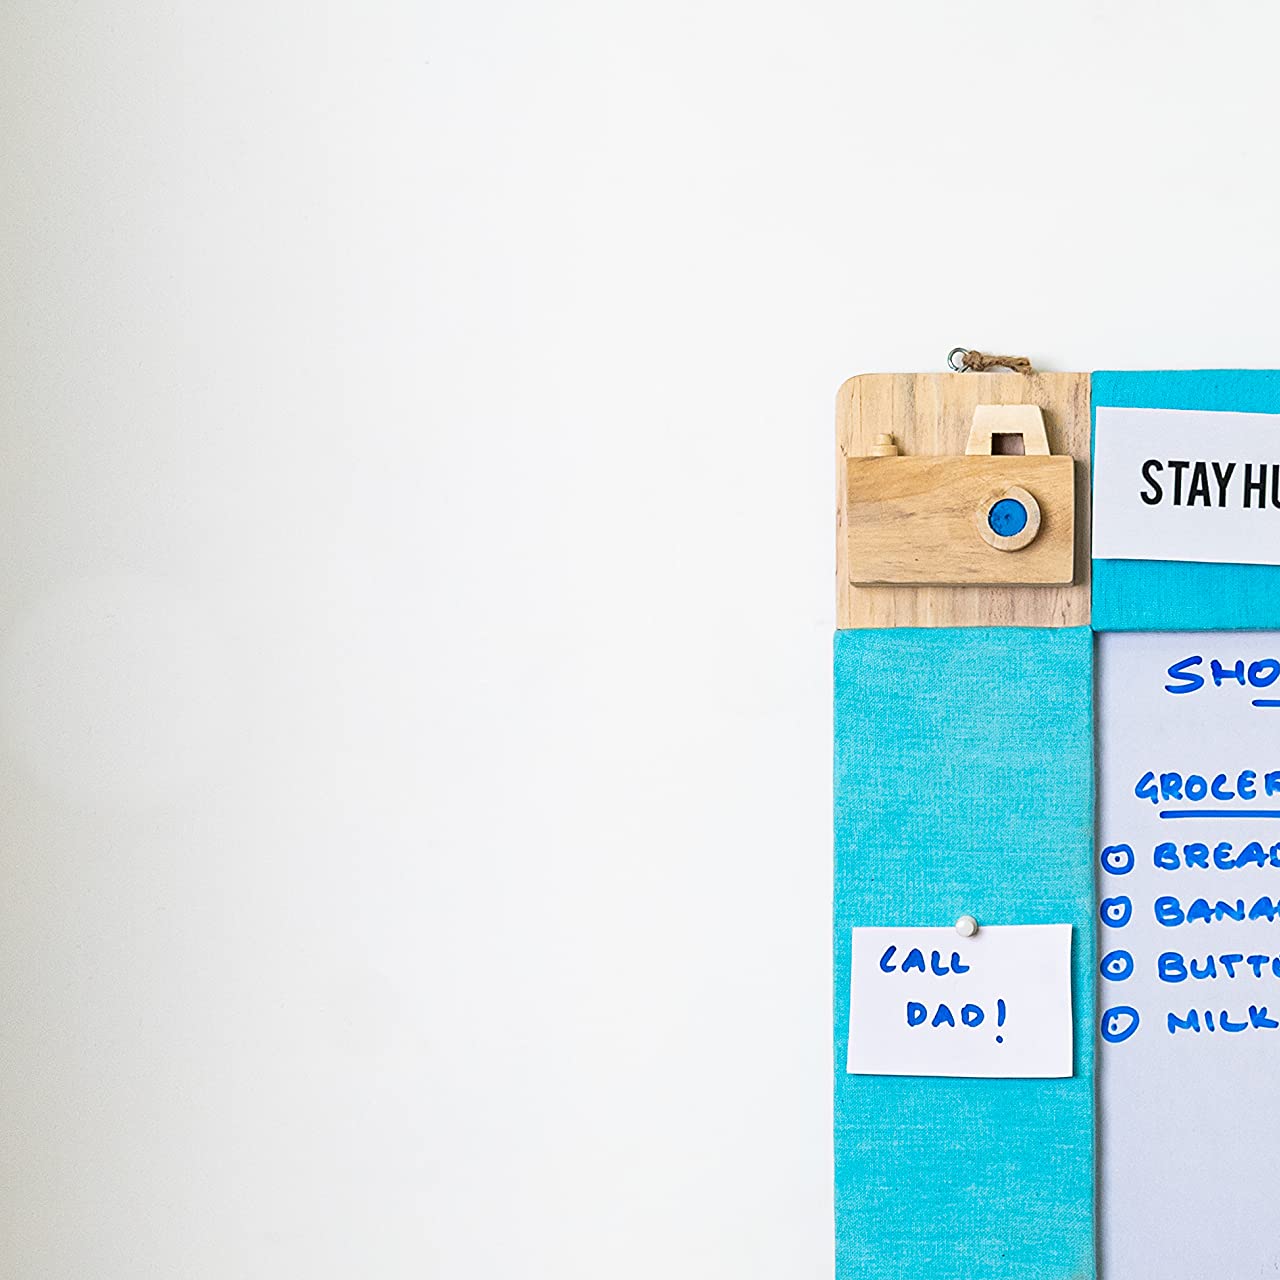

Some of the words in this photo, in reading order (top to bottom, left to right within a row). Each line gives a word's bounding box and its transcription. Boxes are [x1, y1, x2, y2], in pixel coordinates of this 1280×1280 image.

[1140, 459, 1237, 508] STAY
[879, 945, 971, 977] CALL
[906, 998, 1007, 1044] DAD!
[1167, 1005, 1280, 1035] MILK
